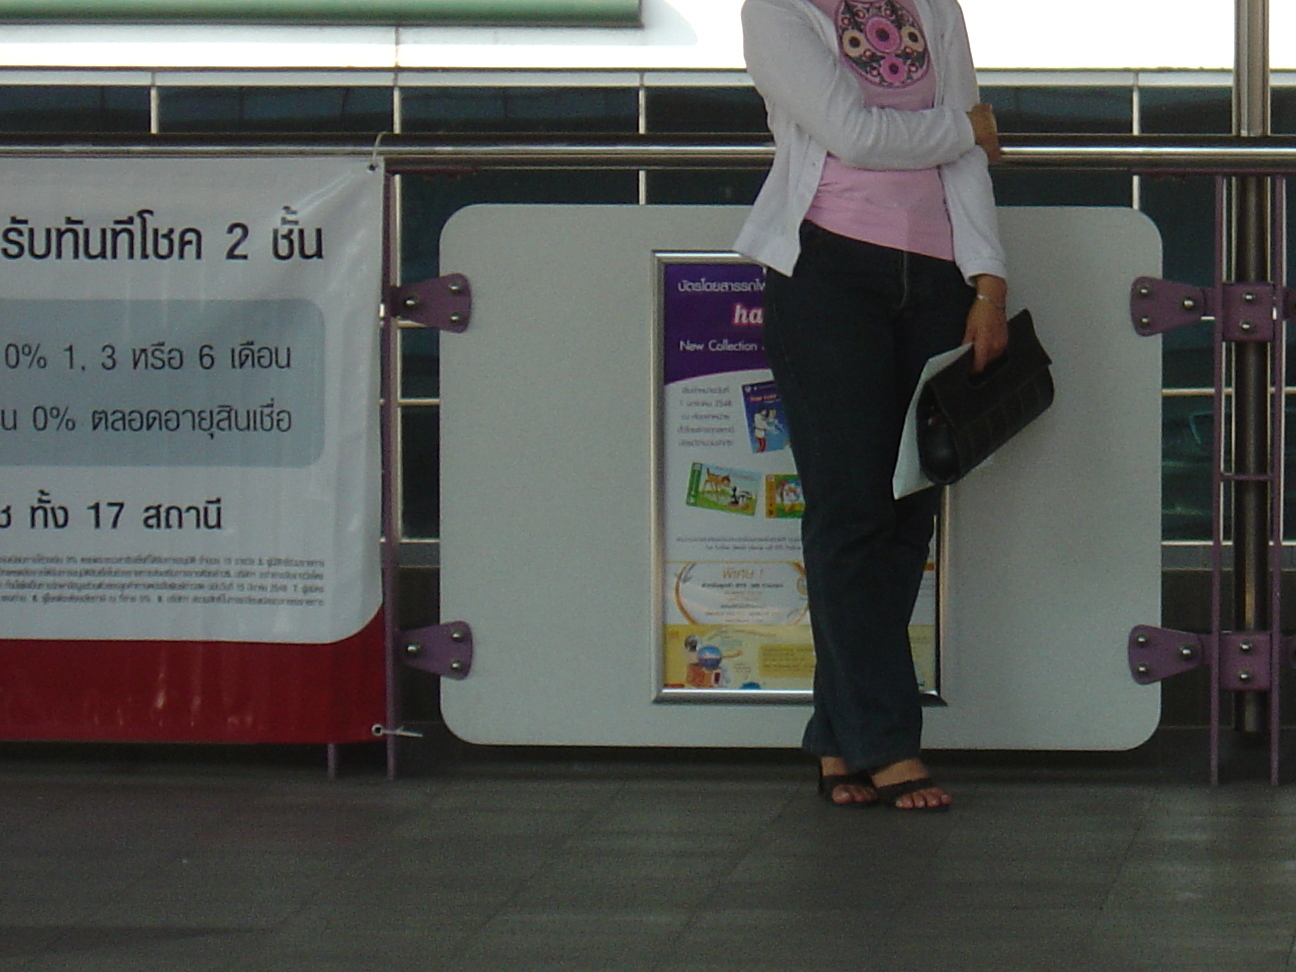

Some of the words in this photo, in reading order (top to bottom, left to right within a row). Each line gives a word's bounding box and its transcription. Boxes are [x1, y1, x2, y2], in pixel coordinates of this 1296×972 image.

[0, 208, 203, 261] รับทันทีโชค
[225, 222, 250, 261] 2
[272, 205, 325, 261] ชั้น
[101, 344, 117, 371] 3
[132, 340, 184, 371] หรือ
[199, 344, 215, 370] 6
[230, 340, 292, 370] เดือน
[680, 339, 704, 352] New
[708, 338, 758, 352] Collection
[33, 404, 76, 432] 0%
[91, 398, 292, 440] ตลอดอายุสินเชื่อ
[29, 489, 69, 530] ทั้ง
[86, 501, 126, 529] 17
[143, 497, 224, 530] สถานี
